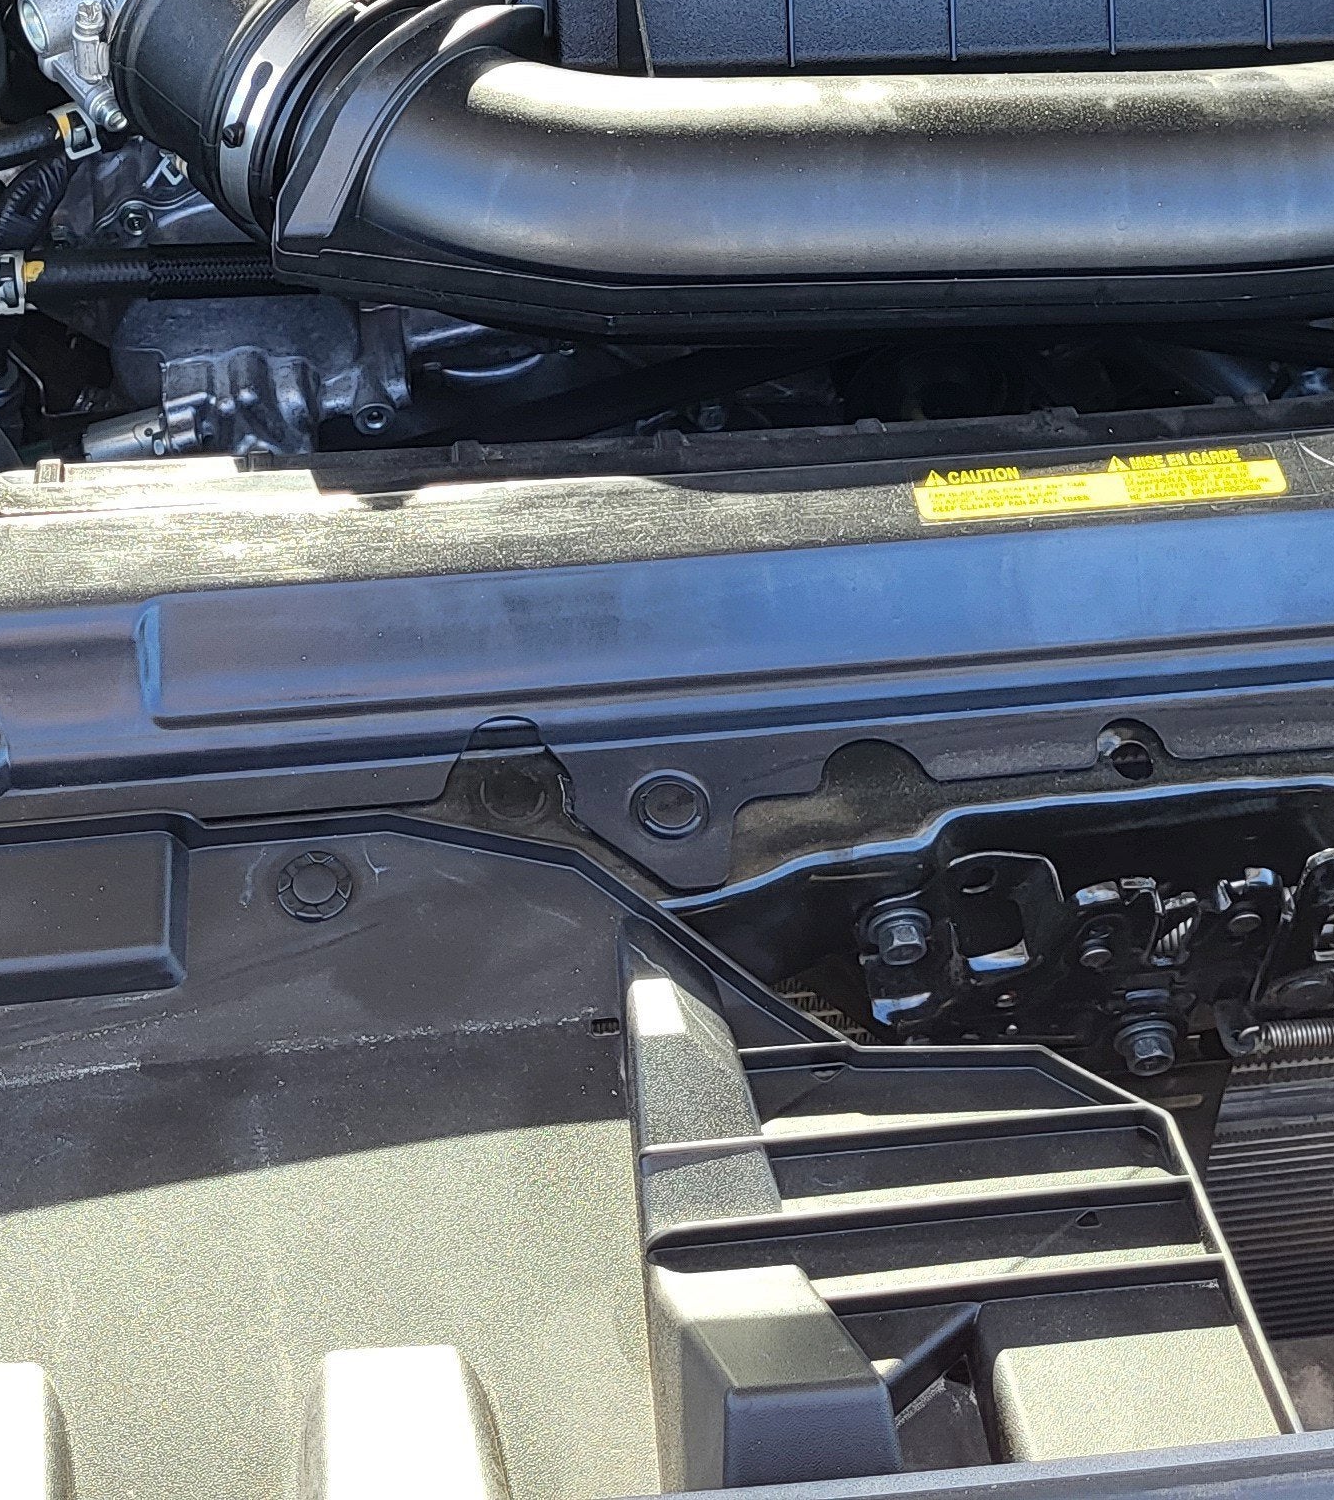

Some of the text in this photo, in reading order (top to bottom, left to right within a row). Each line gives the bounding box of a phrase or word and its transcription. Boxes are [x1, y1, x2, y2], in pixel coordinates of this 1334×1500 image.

[1128, 449, 1242, 470] MISE EN GARDE
[948, 466, 1020, 484] CAUTION
